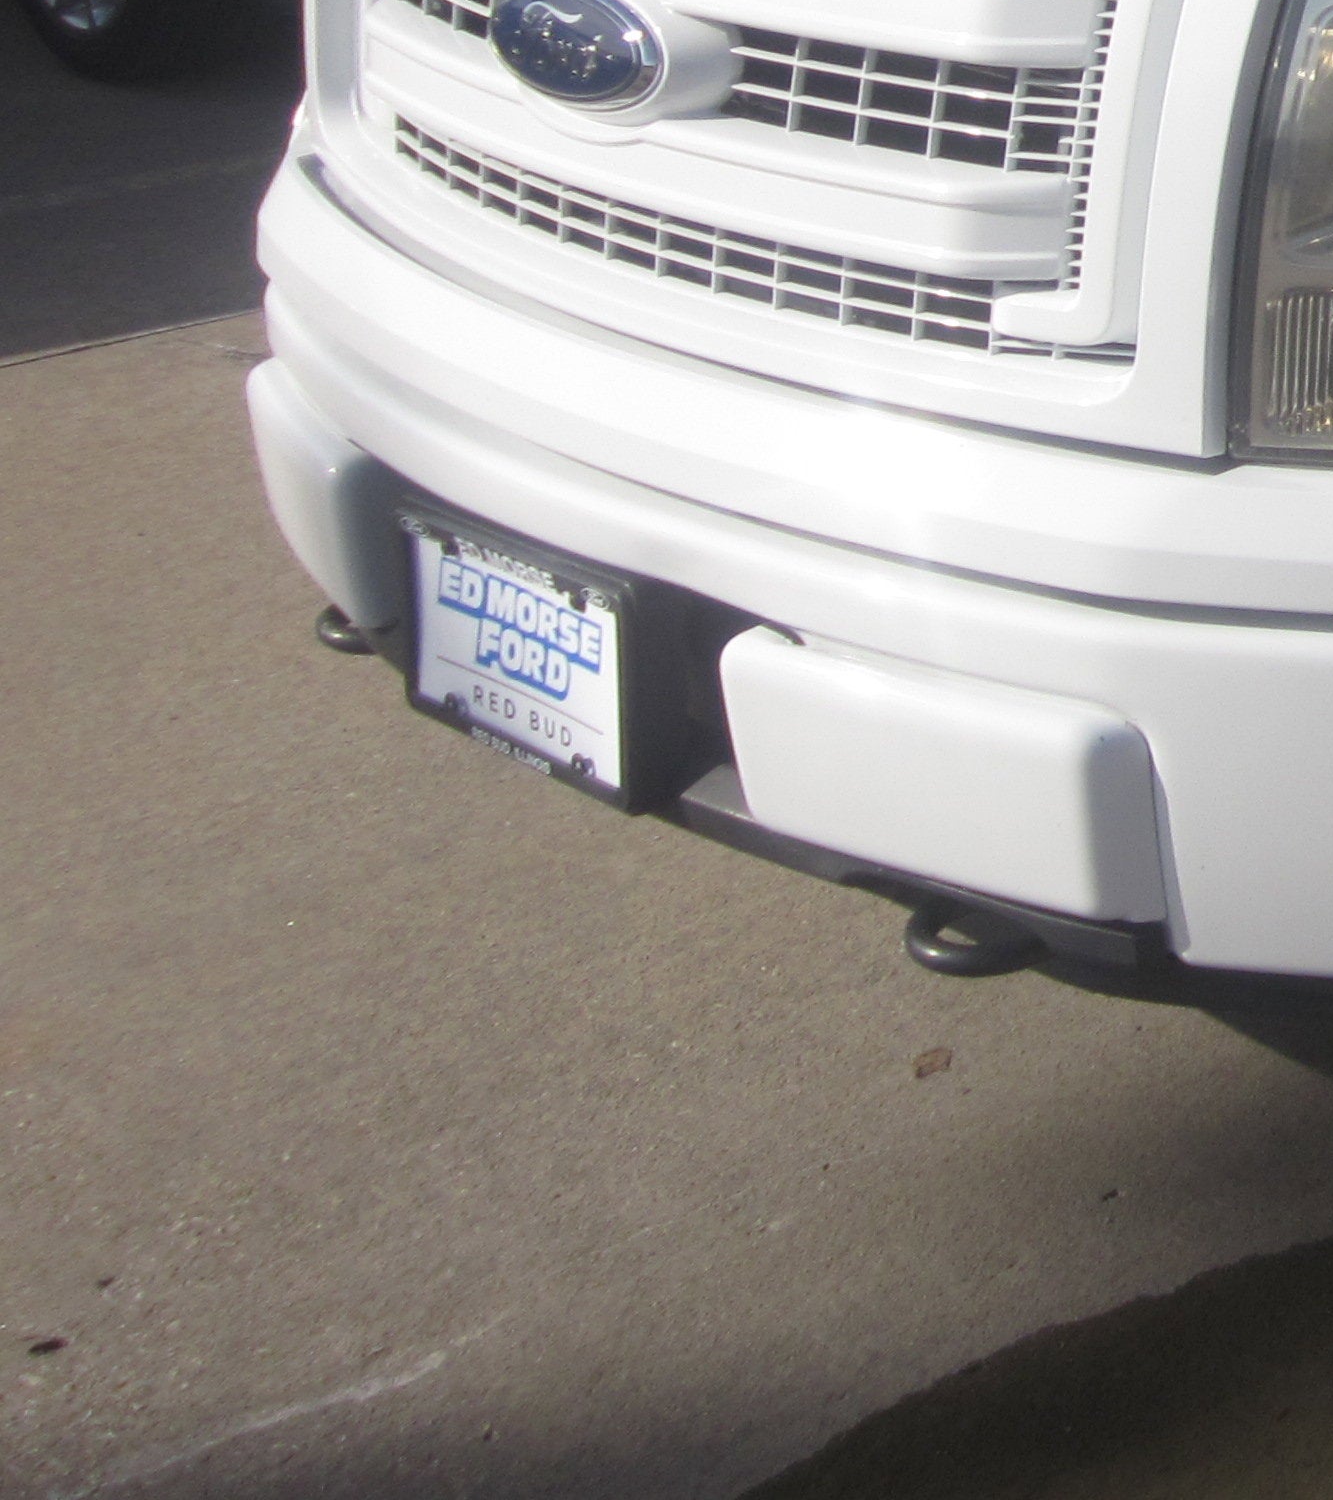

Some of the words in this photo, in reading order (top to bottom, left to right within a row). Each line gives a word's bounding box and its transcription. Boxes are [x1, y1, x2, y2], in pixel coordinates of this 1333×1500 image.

[439, 558, 484, 611] ED
[485, 574, 601, 673] MORSE
[477, 619, 570, 700] FORD
[473, 684, 516, 720] RED
[529, 710, 571, 747] BUD
